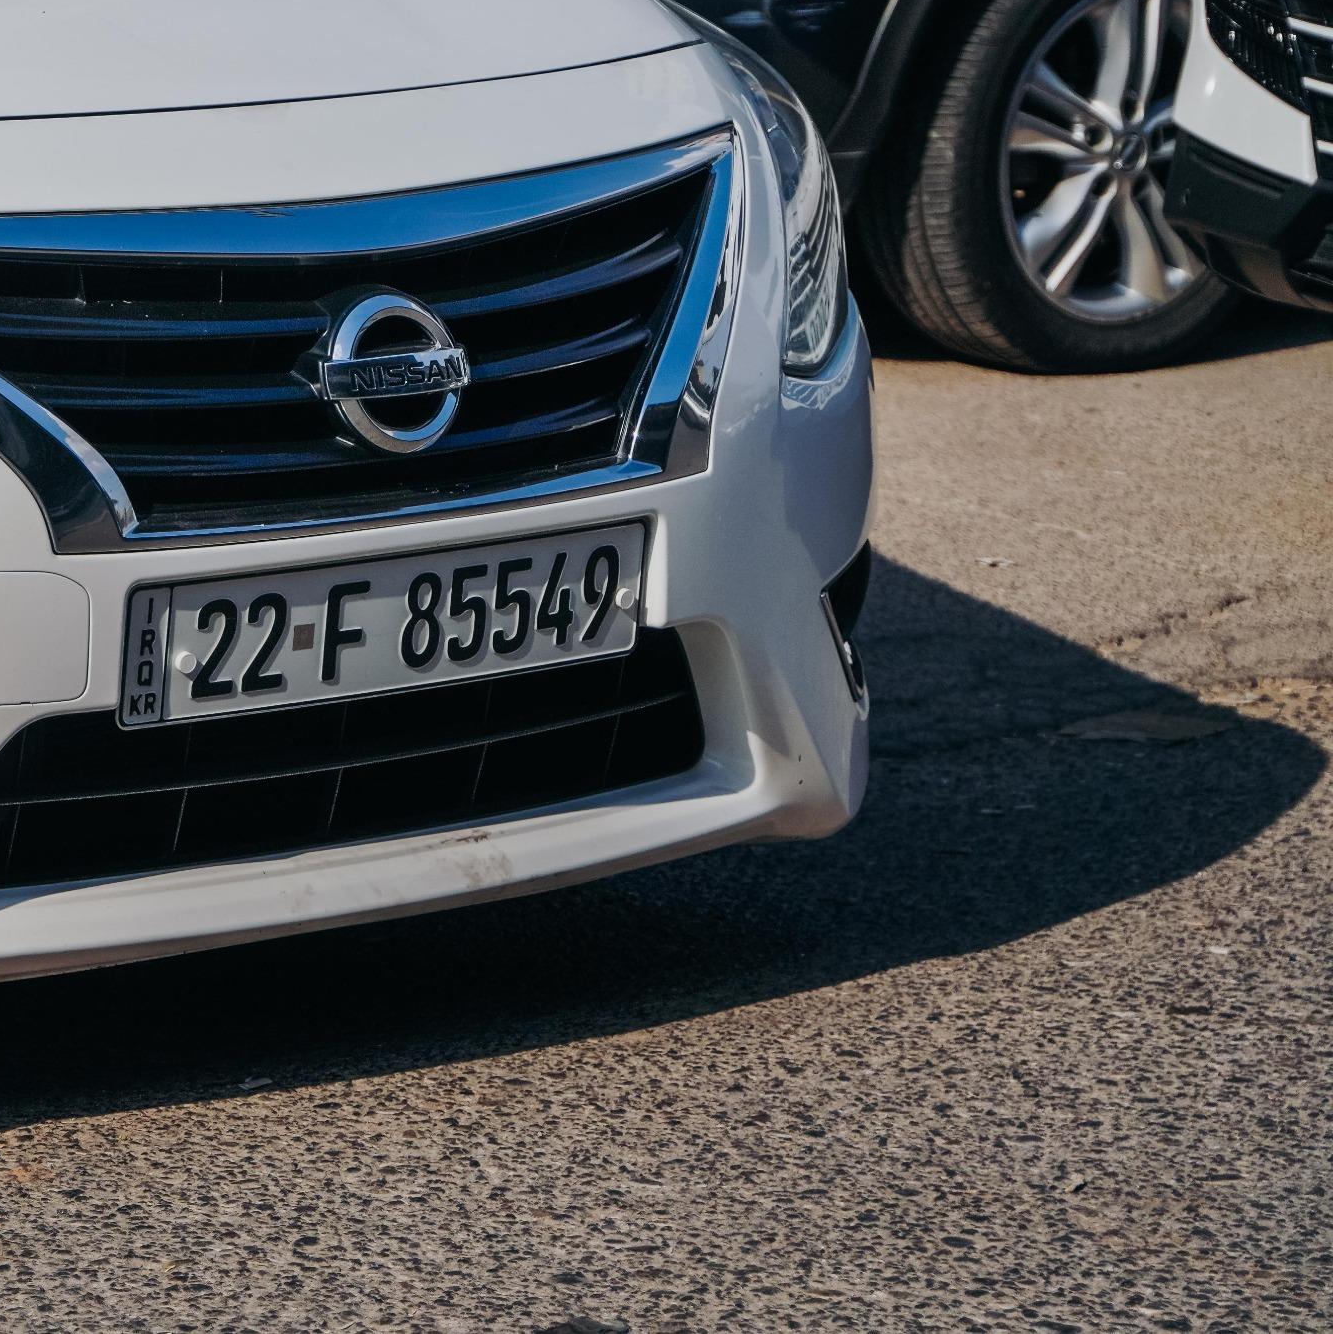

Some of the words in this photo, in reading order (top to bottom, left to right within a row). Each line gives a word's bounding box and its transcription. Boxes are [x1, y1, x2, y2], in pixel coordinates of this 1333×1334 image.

[349, 352, 466, 391] NISSAN
[400, 544, 621, 669] 85549
[129, 692, 157, 716] KR
